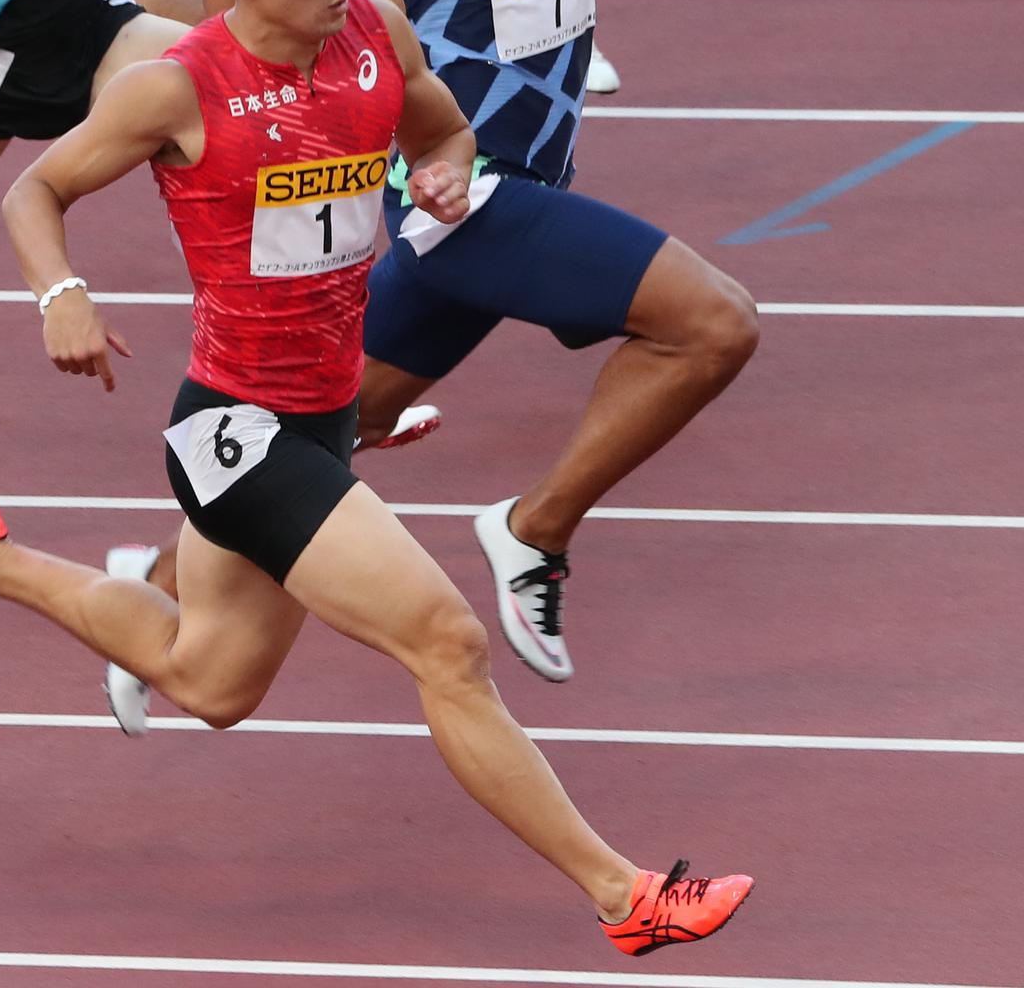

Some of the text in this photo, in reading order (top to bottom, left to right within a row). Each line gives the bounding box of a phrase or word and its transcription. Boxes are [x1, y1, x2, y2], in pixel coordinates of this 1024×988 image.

[227, 84, 299, 118] 日本生命
[265, 156, 387, 202] SEIKO
[315, 203, 333, 255] 1
[214, 413, 243, 469] 6
